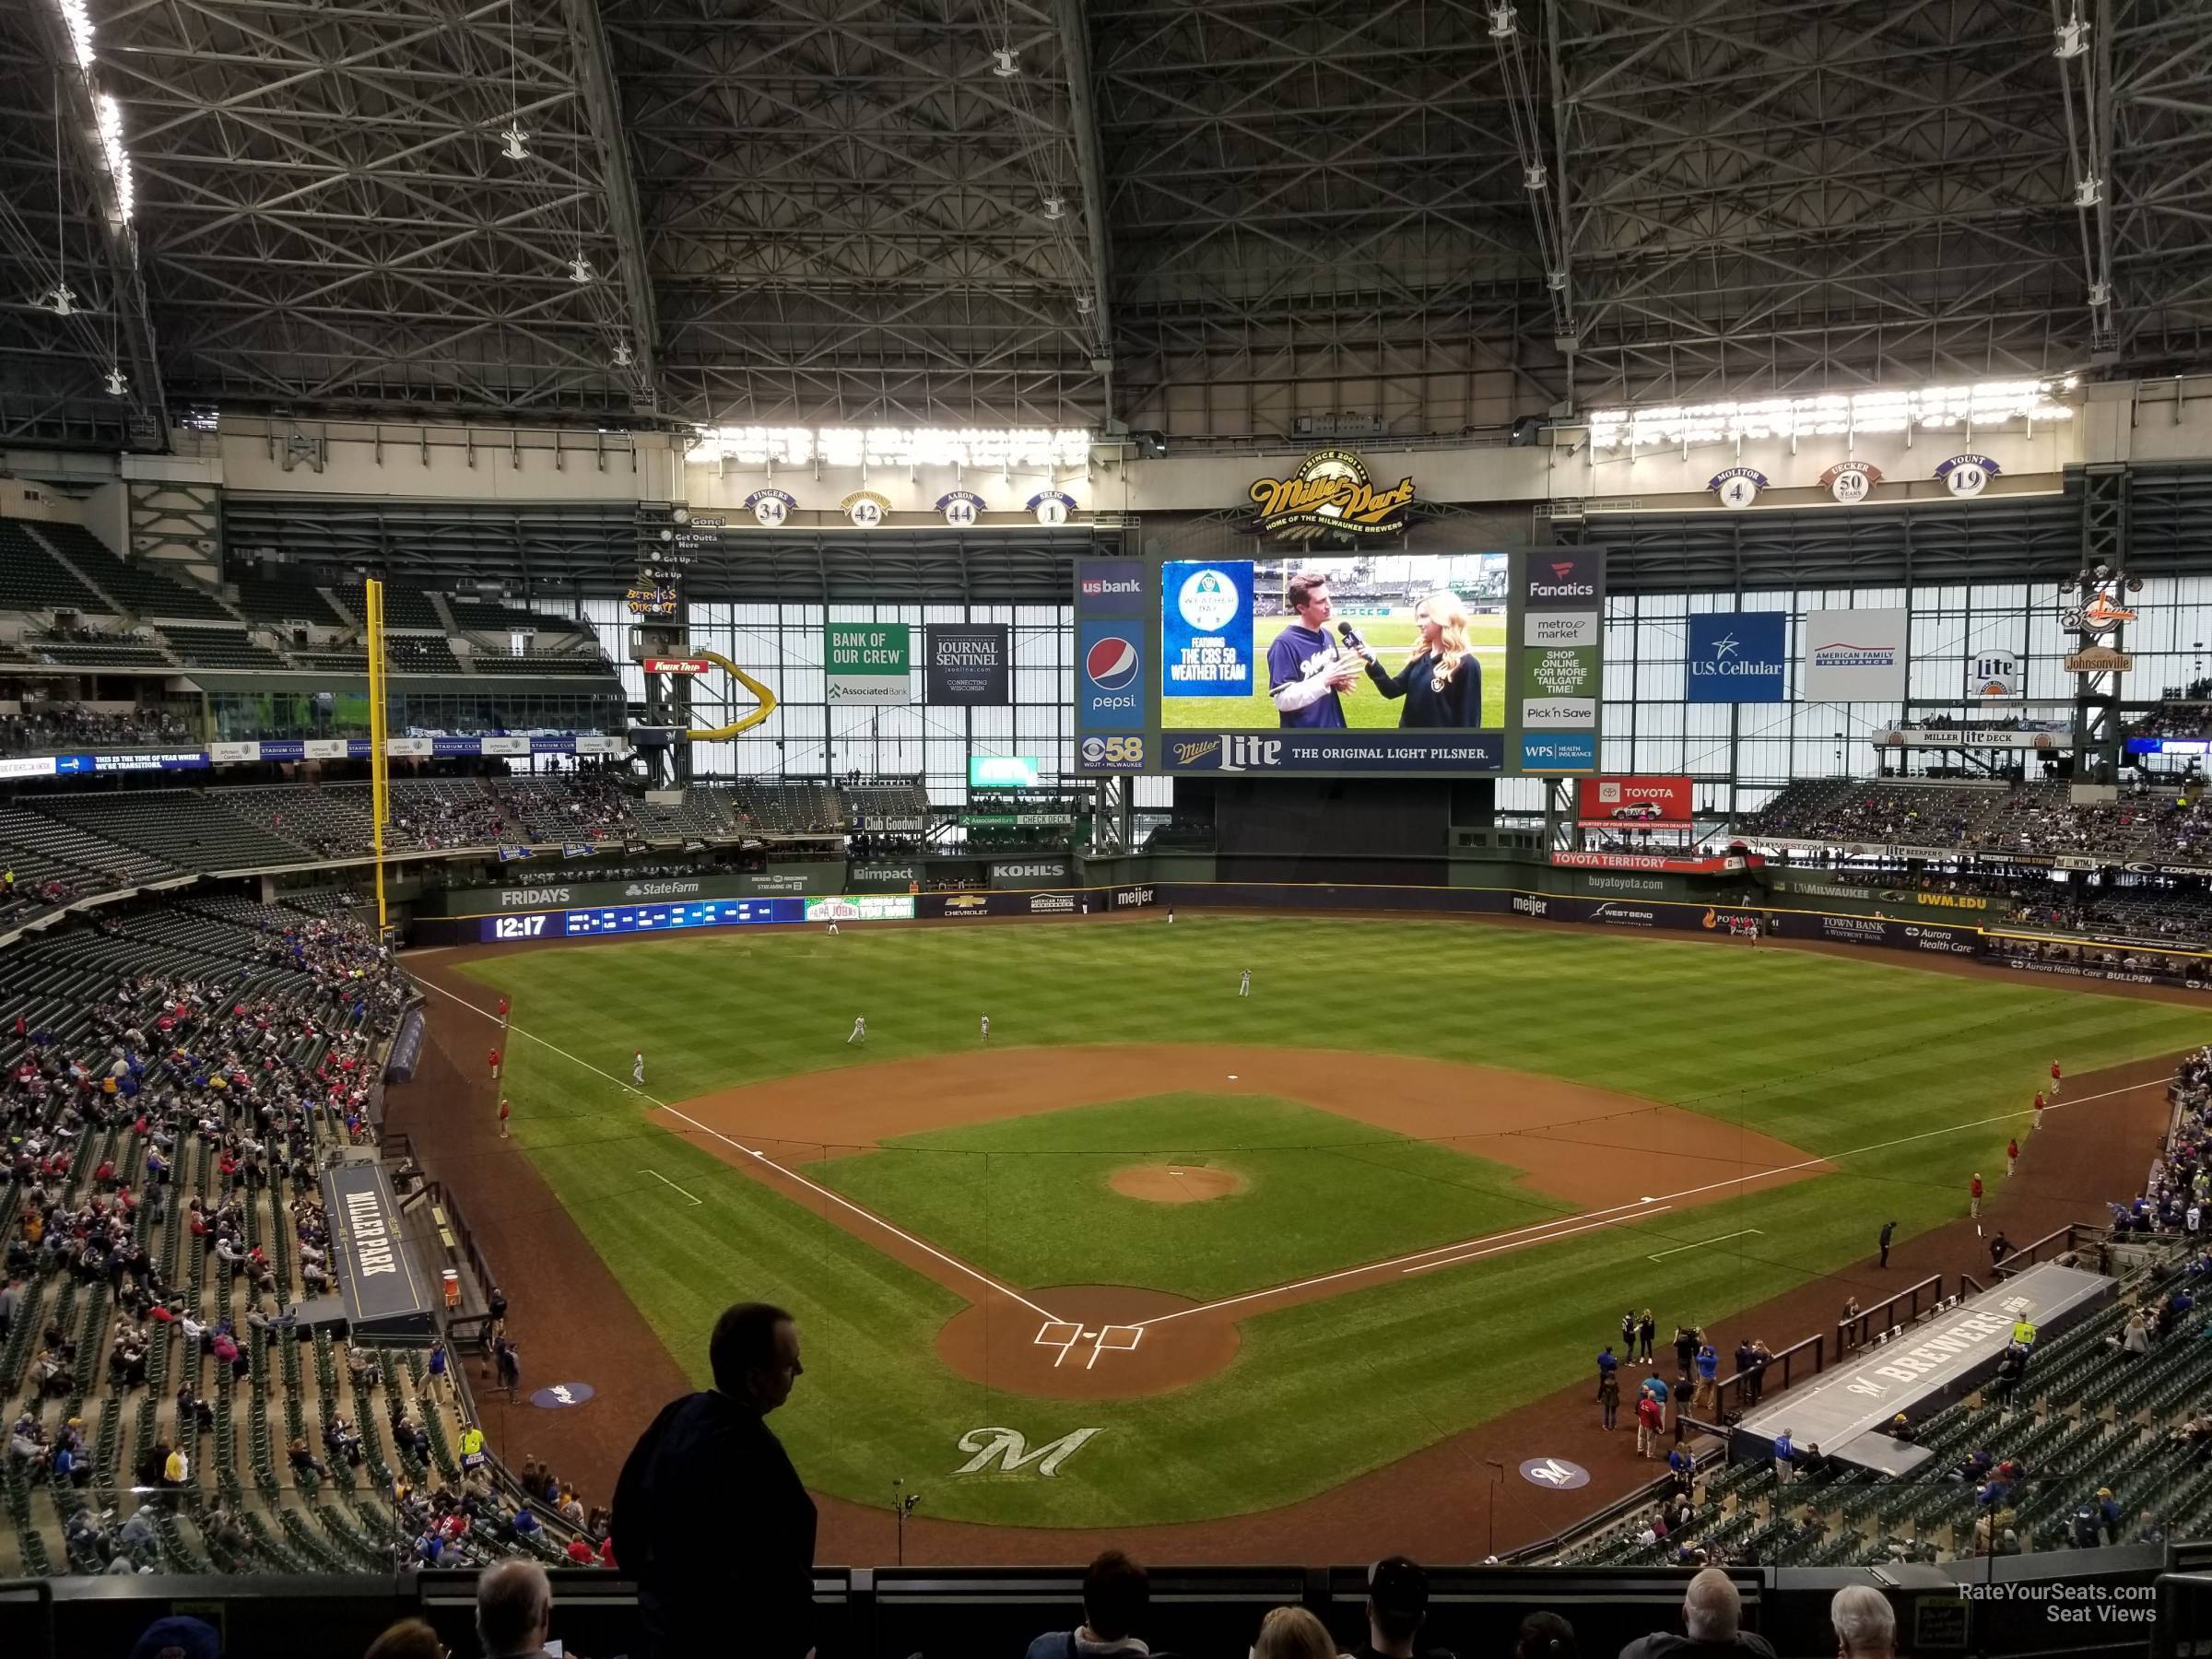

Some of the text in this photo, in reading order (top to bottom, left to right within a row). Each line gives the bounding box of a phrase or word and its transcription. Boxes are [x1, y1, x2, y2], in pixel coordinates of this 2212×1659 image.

[1306, 452, 1359, 468] SINCE 2001
[1949, 455, 1986, 465] YOUNT
[1716, 469, 1760, 481] MOLITOR
[1830, 463, 1870, 473] UECKER
[1840, 475, 1862, 489] 50
[1954, 470, 1982, 490] 19
[752, 489, 788, 500] FINGERS
[847, 490, 886, 503] ROBINSON
[947, 492, 974, 500] AARON
[1039, 491, 1064, 500] SELIG
[1729, 482, 1744, 501] 4
[1250, 474, 1417, 524] Miller Park
[759, 503, 783, 521] 34
[853, 504, 878, 522] 42
[948, 505, 972, 523] 44
[1047, 506, 1058, 523] 1
[691, 517, 725, 525] Gone!
[1265, 518, 1288, 531] HOME
[1318, 517, 1364, 533] MILWAUKEE
[1364, 521, 1404, 533] BREWERS
[679, 556, 691, 564] Up
[1530, 582, 1594, 596] Fanatics
[628, 601, 677, 614] DUGOUT
[1538, 619, 1573, 629] metro
[832, 632, 887, 647] BANK OF
[1538, 629, 1579, 639] market
[935, 641, 999, 654] JOURNAL
[833, 649, 900, 665] OUR CREW
[935, 653, 999, 665] SENTINEL
[1181, 648, 1200, 665] THE
[1201, 648, 1222, 665] CBS
[1547, 651, 1575, 659] SHOP
[1816, 651, 1894, 660] AMERICAN FAMILY
[653, 662, 700, 672] KWIK TRIP
[1541, 659, 1580, 667] ONLINE
[1691, 660, 1783, 676] U.S. Cellular
[1976, 658, 2013, 680] Lite
[2066, 655, 2129, 670] Johnsonville
[1171, 664, 1246, 681] WEATHER TEAM
[1534, 667, 1588, 677] FOR MORE
[1536, 677, 1583, 685] TAILGATE
[1546, 685, 1573, 693] TIME!
[1092, 694, 1135, 710] pepsi
[1527, 708, 1592, 718] Pick Save
[1924, 733, 1959, 741] MILLER
[1105, 736, 1144, 761] 58
[1172, 735, 1282, 771] Miller Lite
[1292, 747, 1489, 759] THE ORIGINAL LIGHT PILSNER.
[1525, 746, 1553, 757] WPS
[96, 762, 117, 771] WE'RE
[1625, 788, 1674, 798] TOYOTA
[865, 816, 923, 830] Club Goodwill
[1022, 816, 1046, 824] CHECK
[1555, 853, 1667, 868] TOYOTA TERRITORY
[2073, 858, 2092, 867] WTMJ
[865, 866, 913, 881] impact
[994, 865, 1065, 877] KOHL'S
[1589, 876, 1664, 890] buyatoyota.com
[501, 888, 570, 905] FRIDAYS
[1118, 887, 1153, 905] meijer
[1917, 893, 1987, 909] UWM.EDU
[808, 907, 834, 918] PAPA
[1512, 895, 1547, 916] meijer
[496, 915, 547, 938] 12:17
[1823, 916, 1886, 934] TOWN BANK
[1830, 929, 1882, 941] WINTRUST BANK
[1921, 929, 1952, 940] Aurora
[1920, 938, 1972, 953] Health Care
[2026, 962, 2153, 984] Aurora Health Care BULLPEN
[346, 1191, 397, 1277] MILLER PARK
[1874, 1312, 2015, 1382] BREWERS
